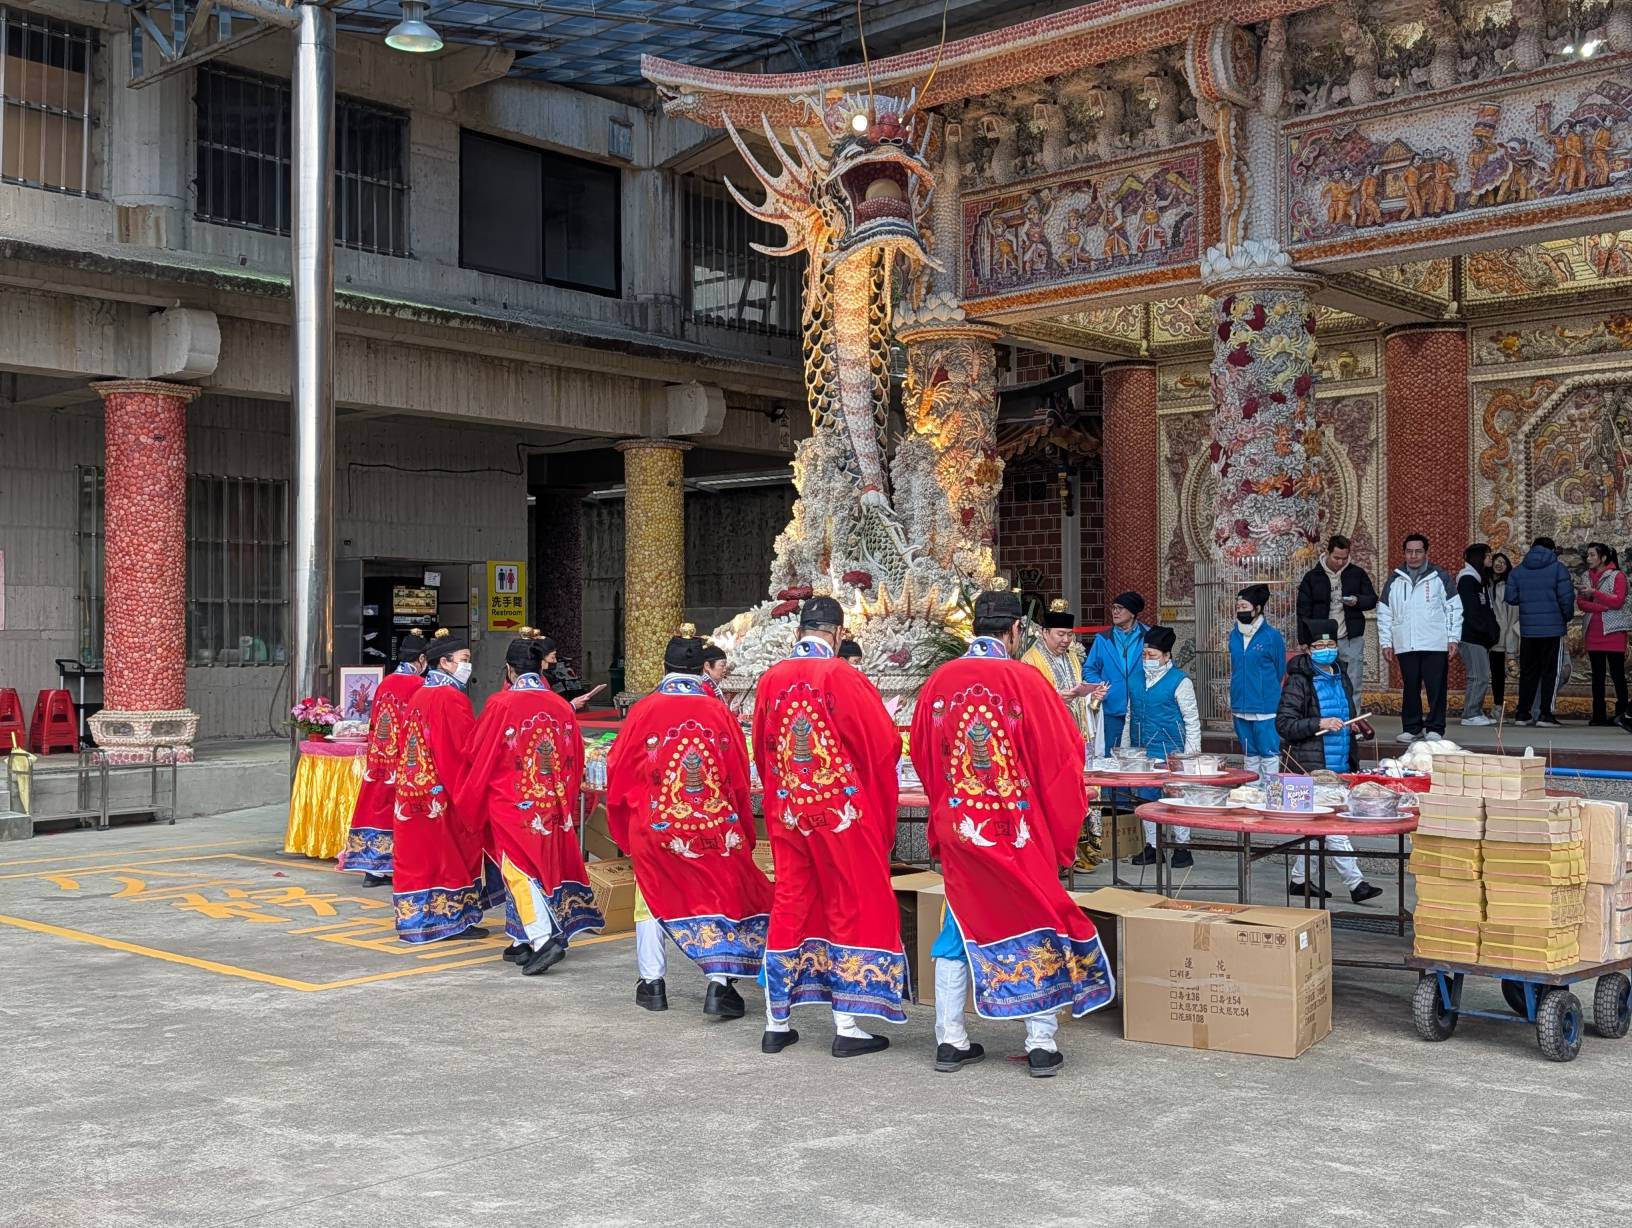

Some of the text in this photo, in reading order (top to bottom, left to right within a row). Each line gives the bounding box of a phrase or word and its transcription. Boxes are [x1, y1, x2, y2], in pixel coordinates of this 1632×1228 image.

[491, 595, 523, 608] 洗手間
[491, 608, 523, 617] Restroom
